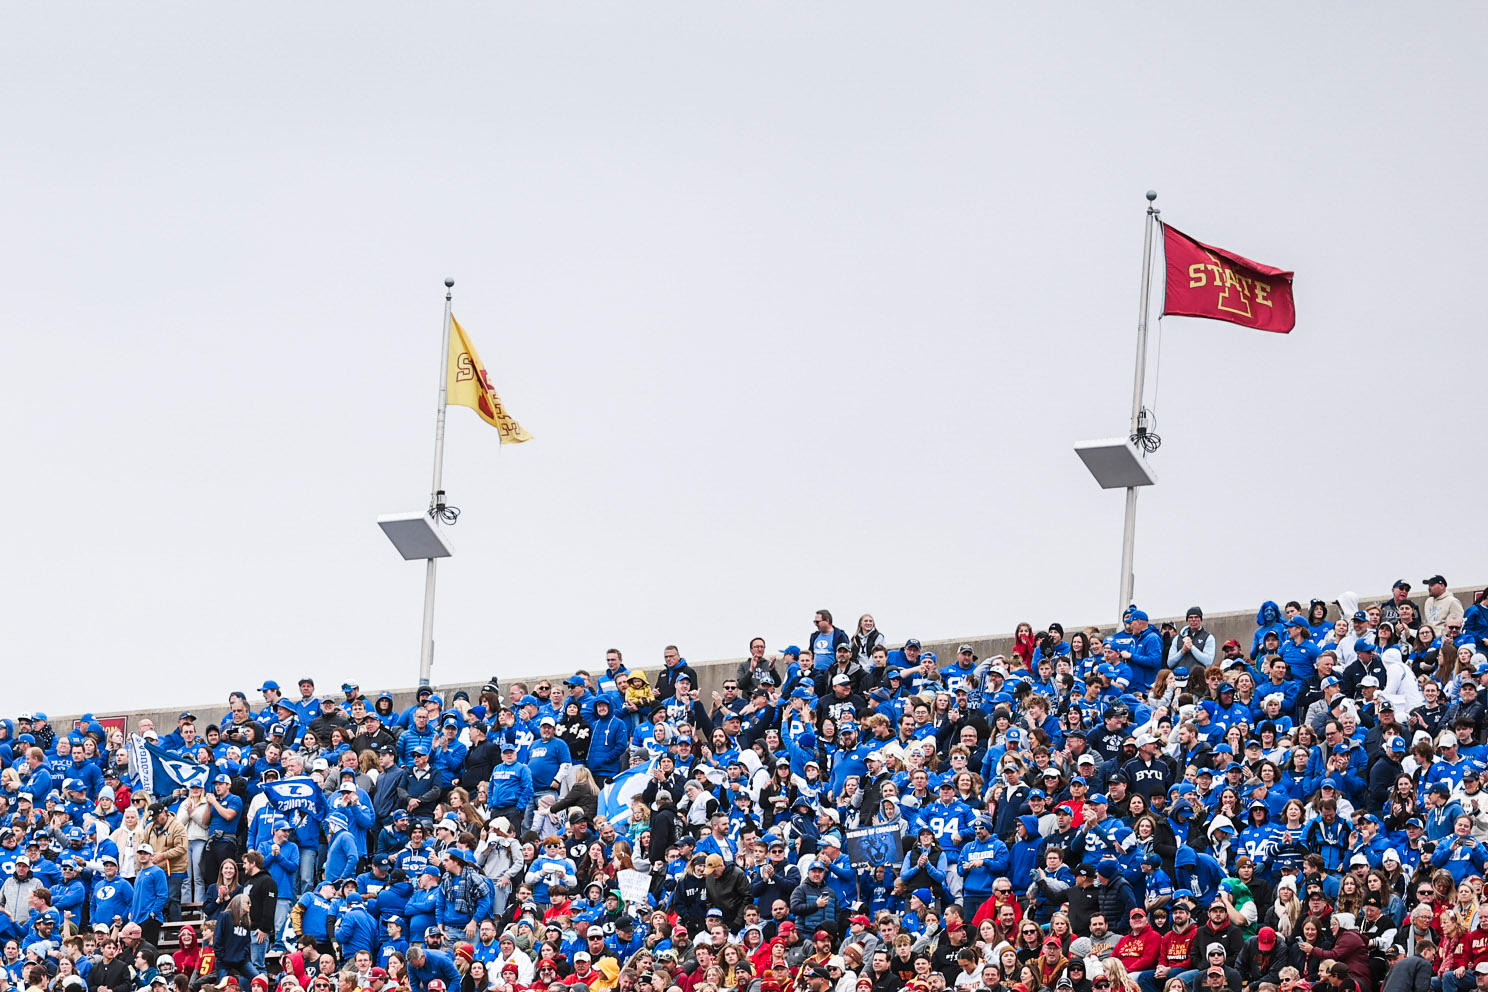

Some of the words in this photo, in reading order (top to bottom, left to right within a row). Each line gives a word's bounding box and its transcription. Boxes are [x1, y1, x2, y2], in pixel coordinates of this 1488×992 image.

[1189, 263, 1273, 307] STATE
[1135, 769, 1162, 781] BYU
[846, 830, 869, 839] BEWARE
[876, 824, 900, 834] COUGARS
[930, 818, 959, 838] 94
